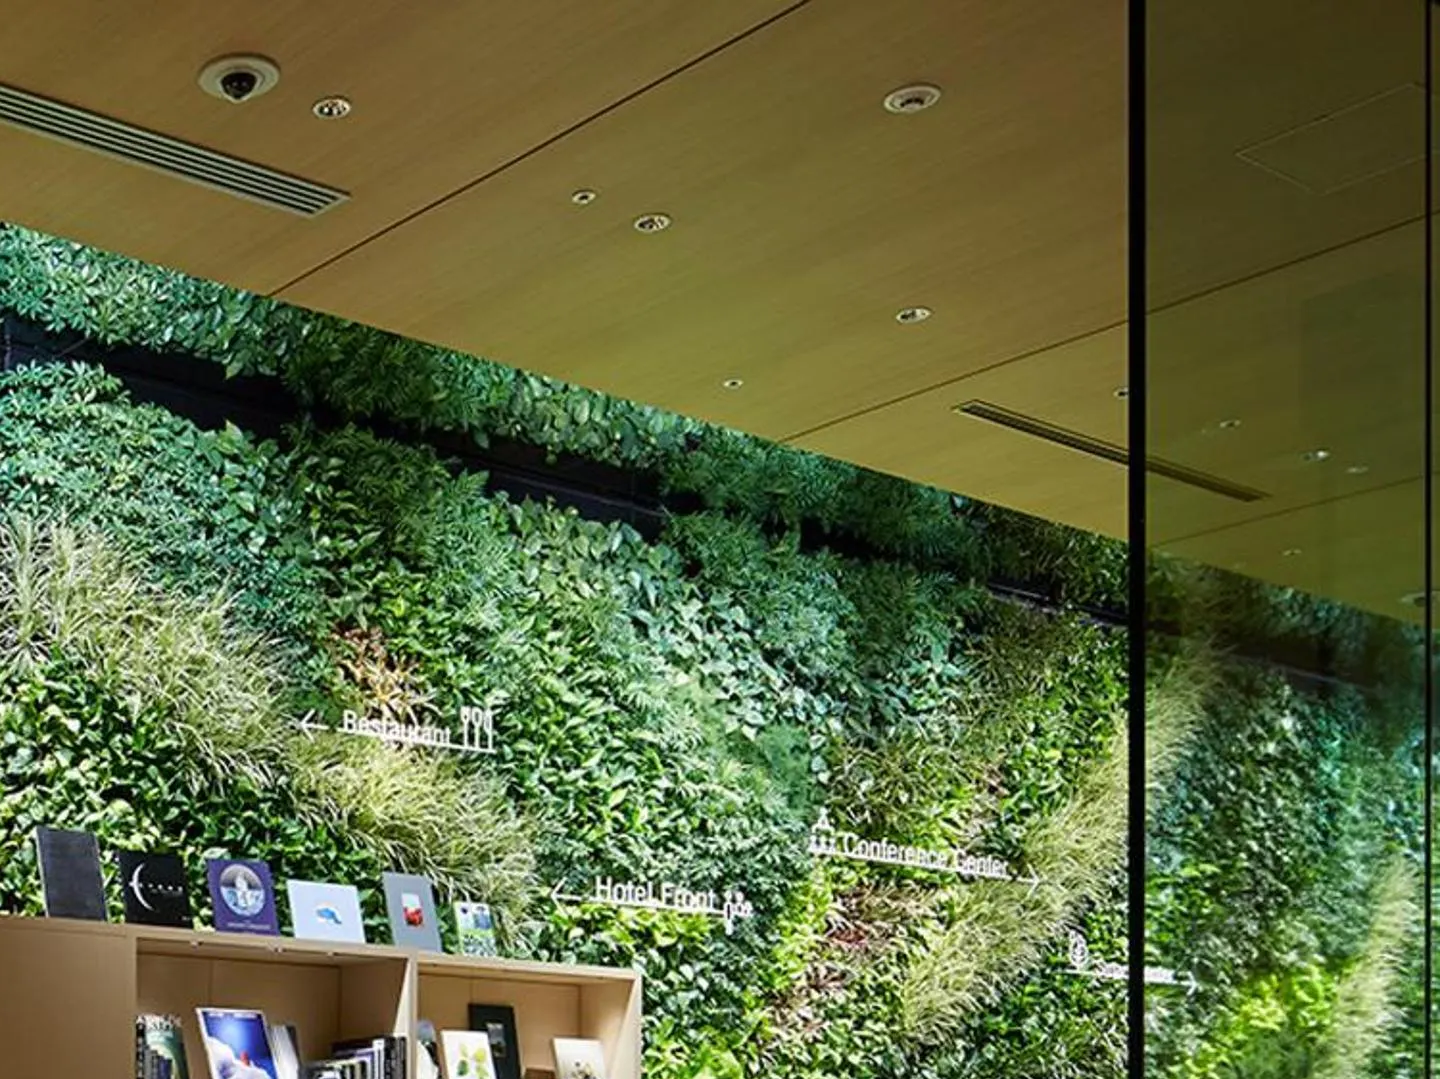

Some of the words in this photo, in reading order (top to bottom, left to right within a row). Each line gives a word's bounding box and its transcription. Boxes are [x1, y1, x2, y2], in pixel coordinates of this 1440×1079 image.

[343, 709, 452, 745] Restaurant
[842, 832, 949, 868] Conference
[955, 848, 1010, 878] Center
[595, 874, 654, 905] Hotel
[661, 881, 718, 912] Front
